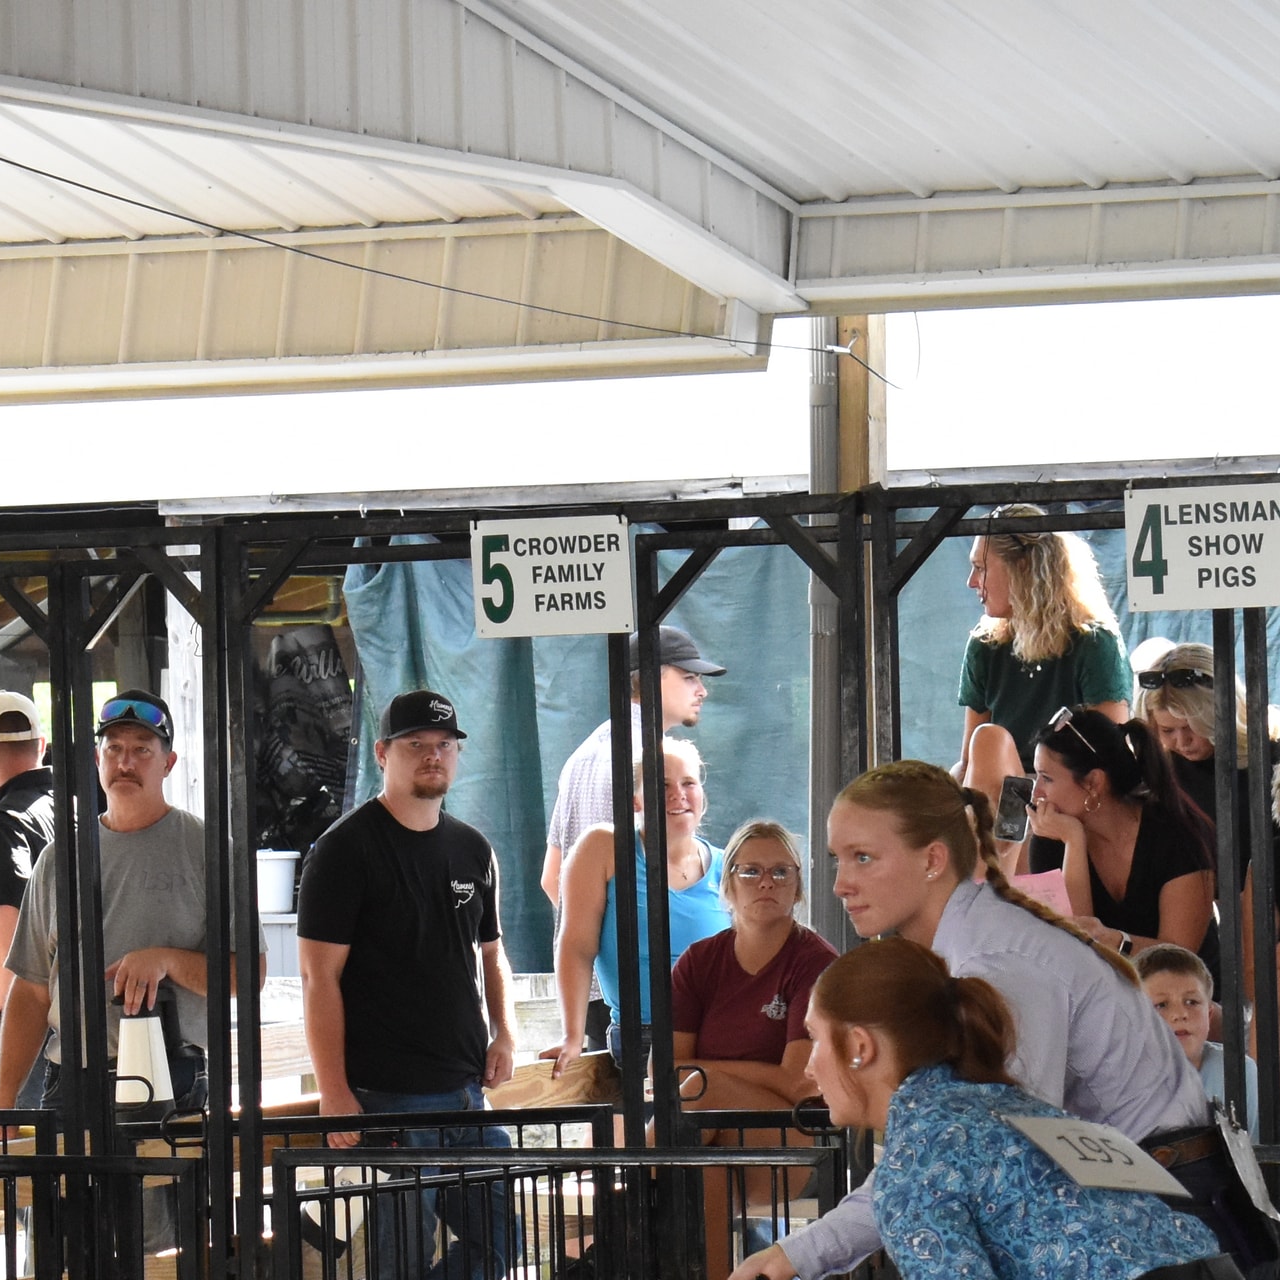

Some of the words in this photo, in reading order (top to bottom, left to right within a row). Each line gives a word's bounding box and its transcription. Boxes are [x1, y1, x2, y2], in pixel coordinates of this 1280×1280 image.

[512, 533, 621, 557] CROWDER
[1132, 503, 1169, 595] 4
[1187, 532, 1264, 557] SHOW
[481, 533, 515, 624] 5
[532, 562, 605, 584] FAMILY
[1197, 565, 1257, 589] PIGS
[534, 590, 607, 613] FARMS
[1056, 1134, 1135, 1166] 195
